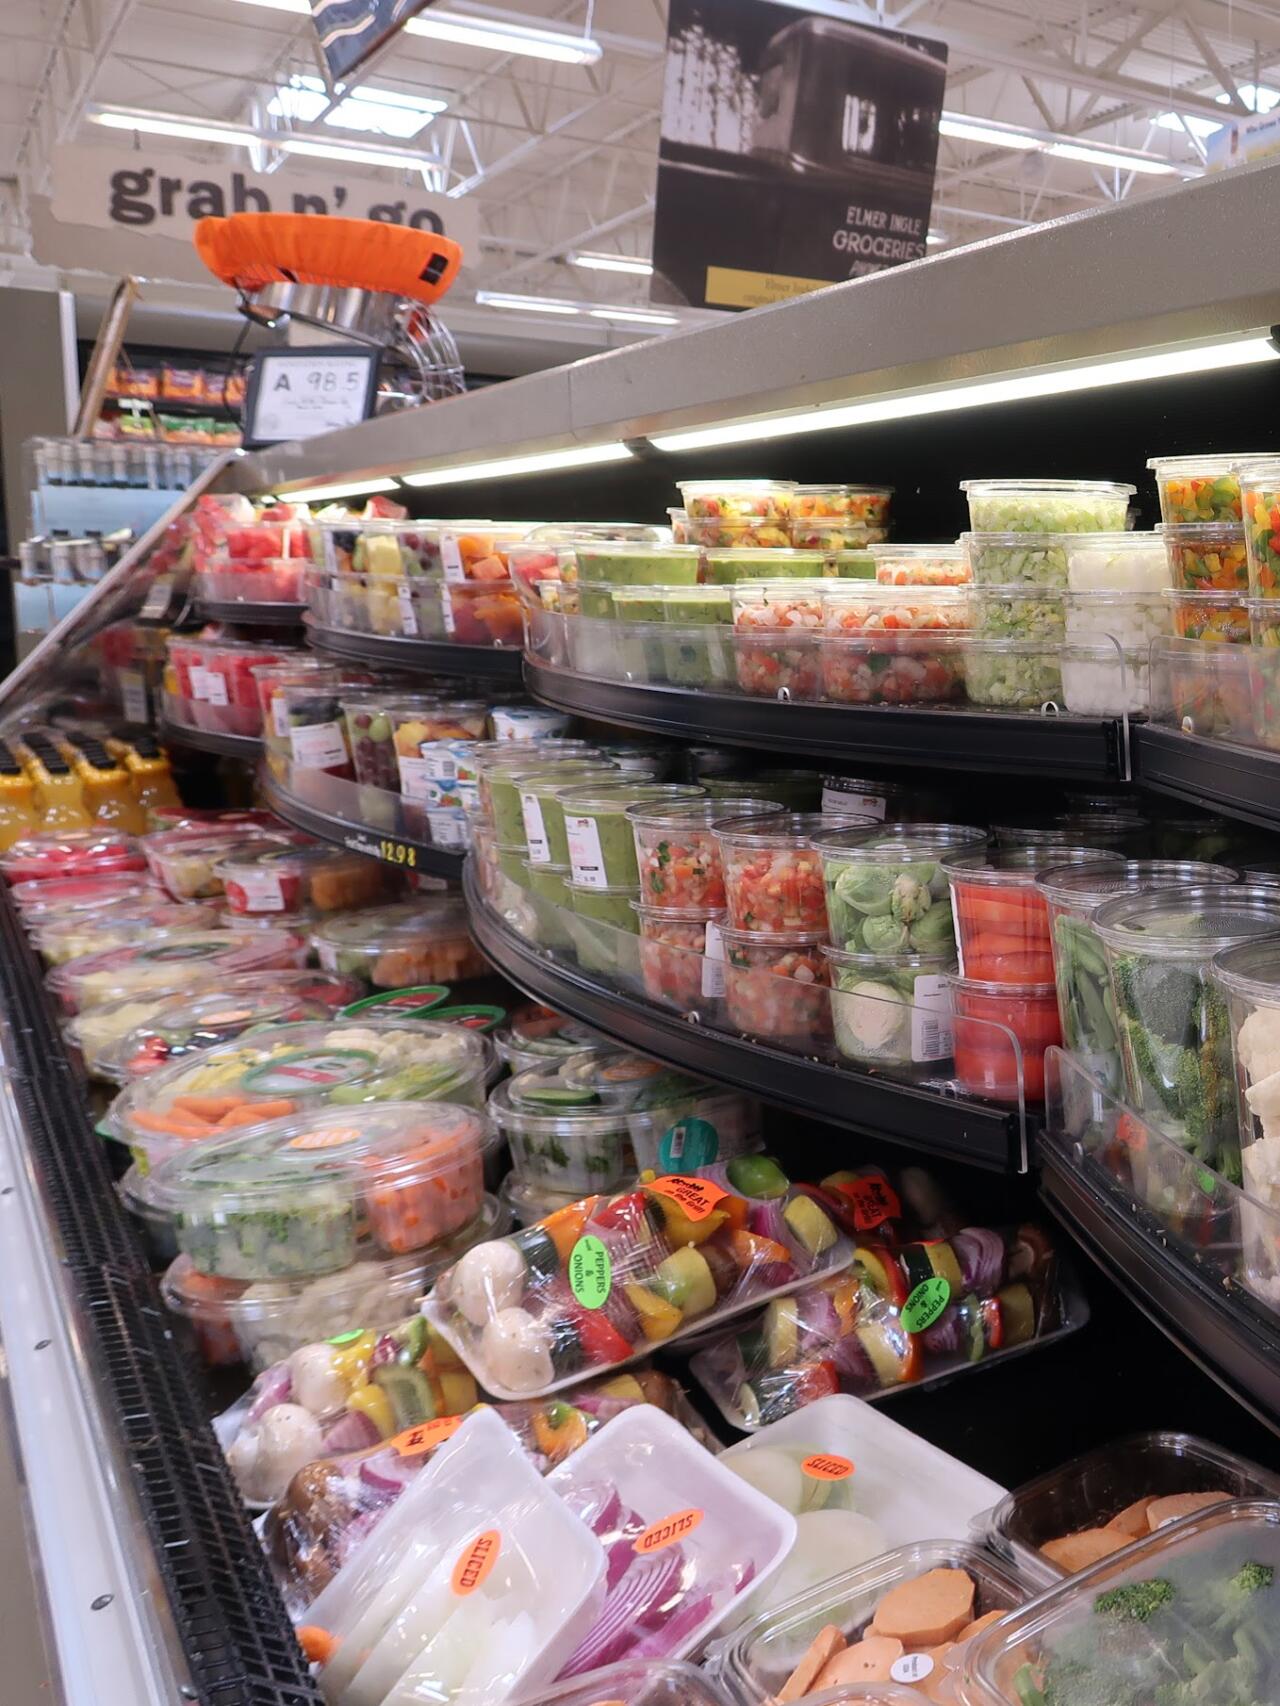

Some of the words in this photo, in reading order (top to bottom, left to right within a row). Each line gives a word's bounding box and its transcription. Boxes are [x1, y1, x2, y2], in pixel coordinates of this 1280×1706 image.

[846, 205, 888, 229] ELMER
[889, 213, 922, 236] INGLE
[832, 229, 926, 260] GROCERIES
[273, 372, 292, 392] A
[675, 1187, 710, 1206] GREAT
[573, 1254, 585, 1294] ONIONS
[595, 1251, 606, 1294] PEPPERS
[905, 1283, 929, 1313] ONIONS
[916, 1294, 945, 1329] PEPPERS
[807, 1457, 850, 1476] SLICED
[644, 1513, 694, 1549] SLICED
[459, 1537, 493, 1588] SLICED
